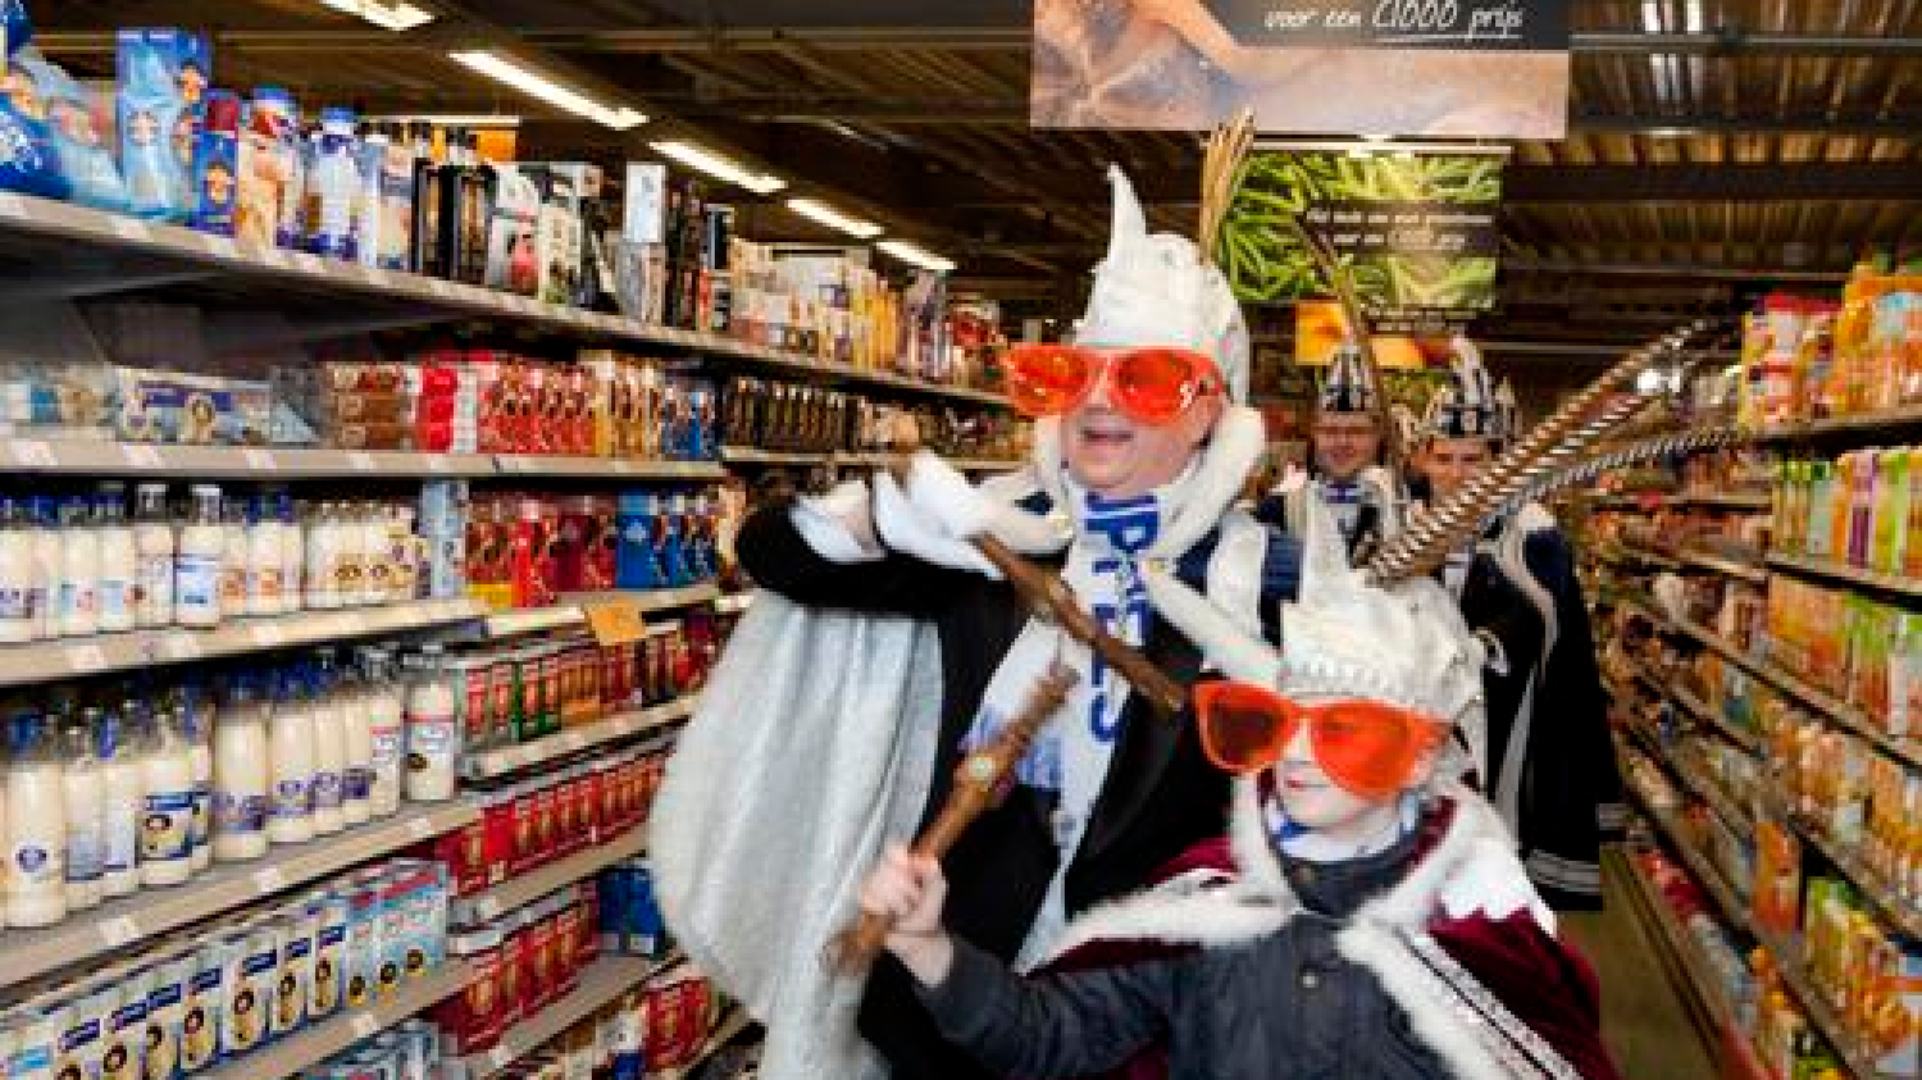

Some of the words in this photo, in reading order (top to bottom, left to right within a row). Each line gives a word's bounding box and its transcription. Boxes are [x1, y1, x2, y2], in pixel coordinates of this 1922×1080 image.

[1264, 10, 1319, 29] voor
[1323, 10, 1361, 28] een
[1465, 1, 1523, 42] prijs
